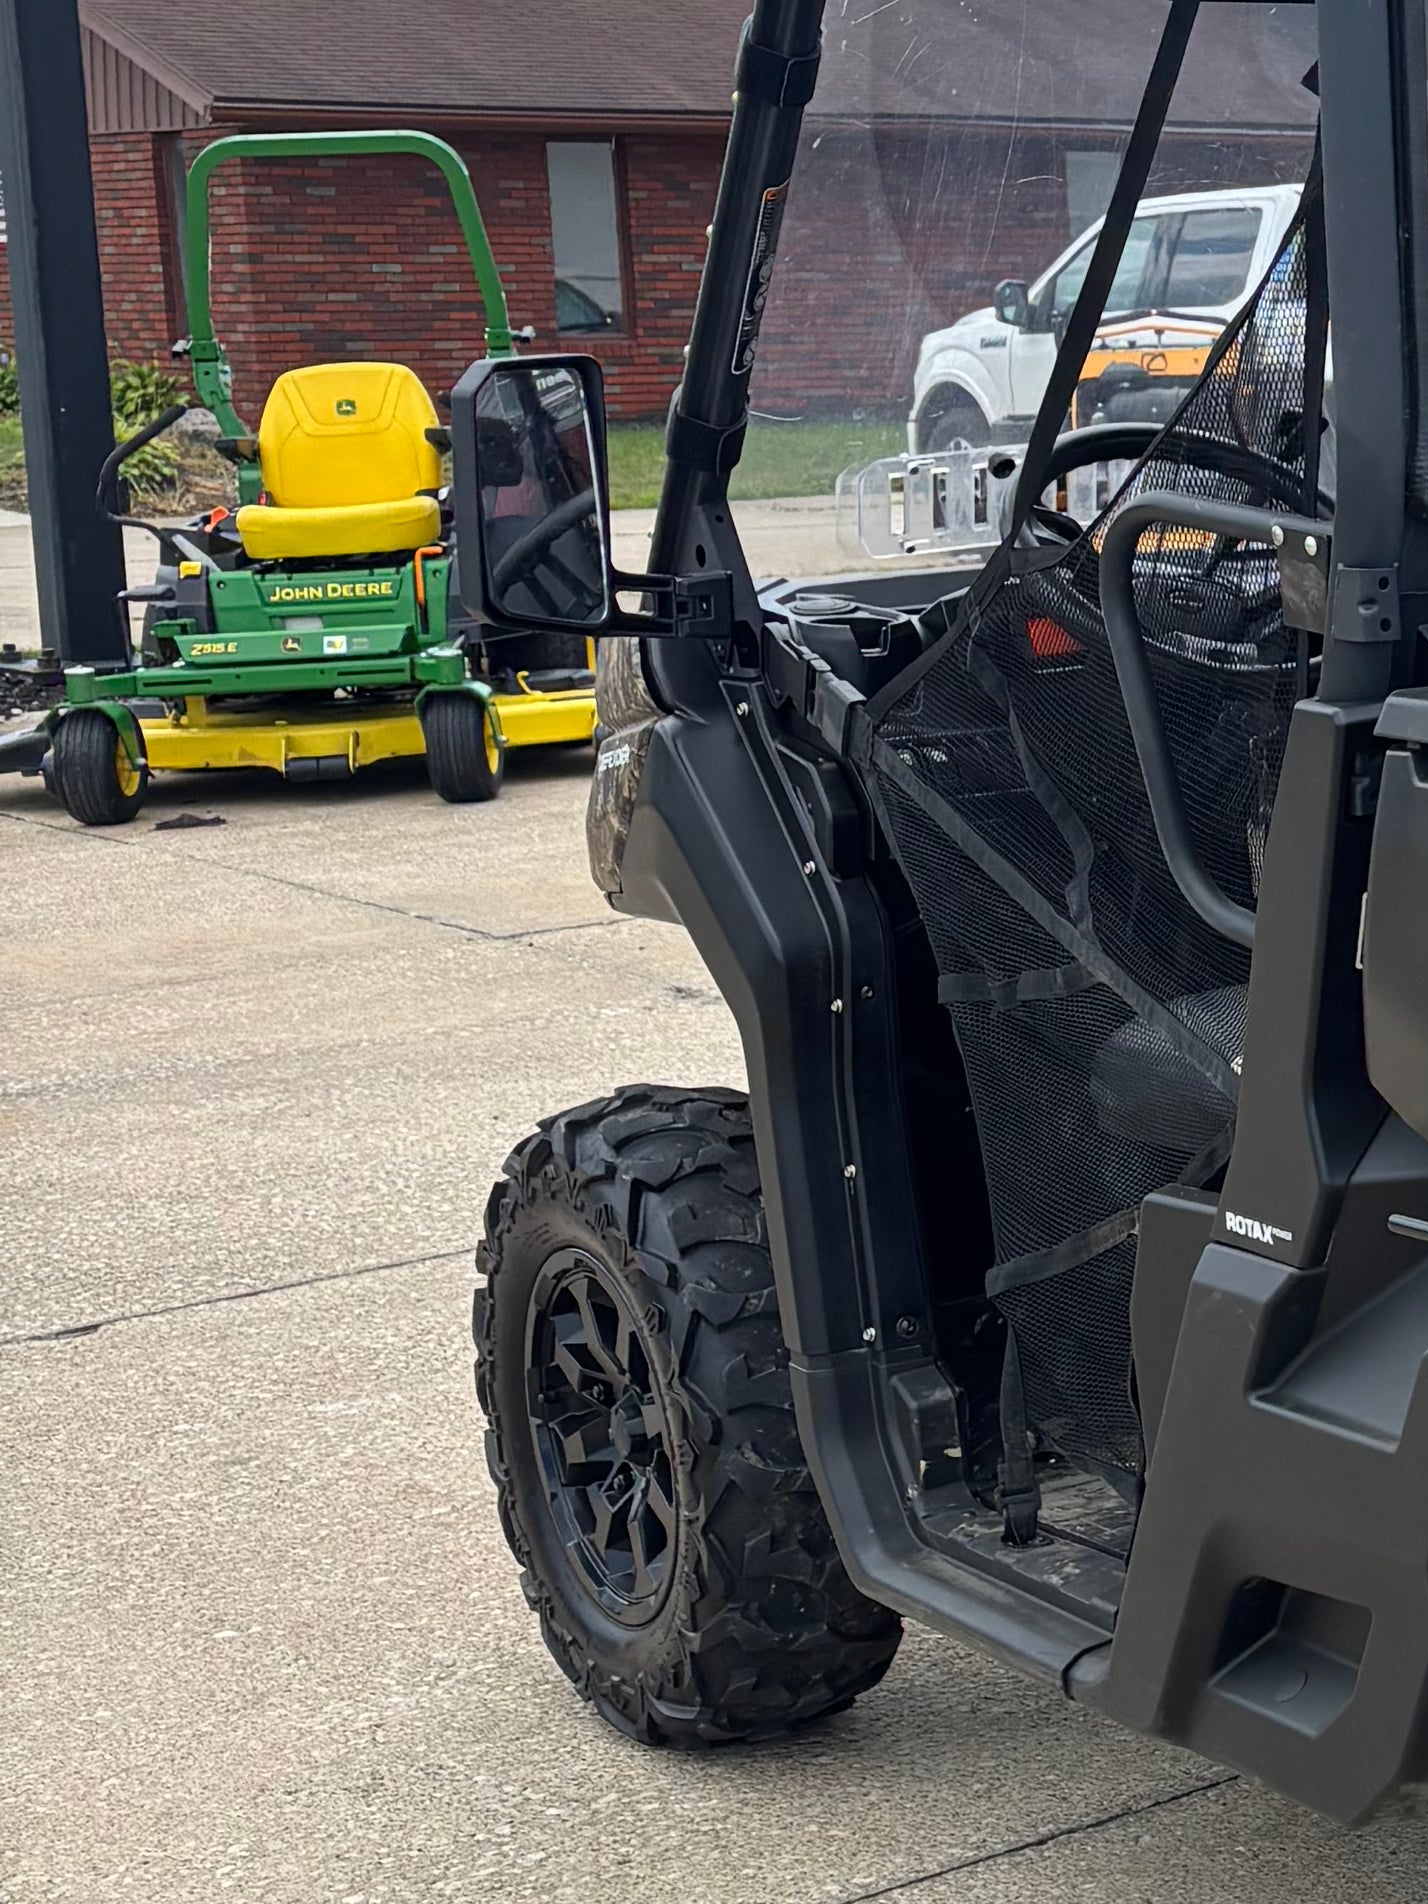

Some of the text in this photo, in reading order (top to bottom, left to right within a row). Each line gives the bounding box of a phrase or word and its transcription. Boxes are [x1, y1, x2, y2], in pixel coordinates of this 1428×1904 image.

[270, 581, 393, 602] JOHN DEERE
[1225, 1211, 1274, 1245] ROTAX
